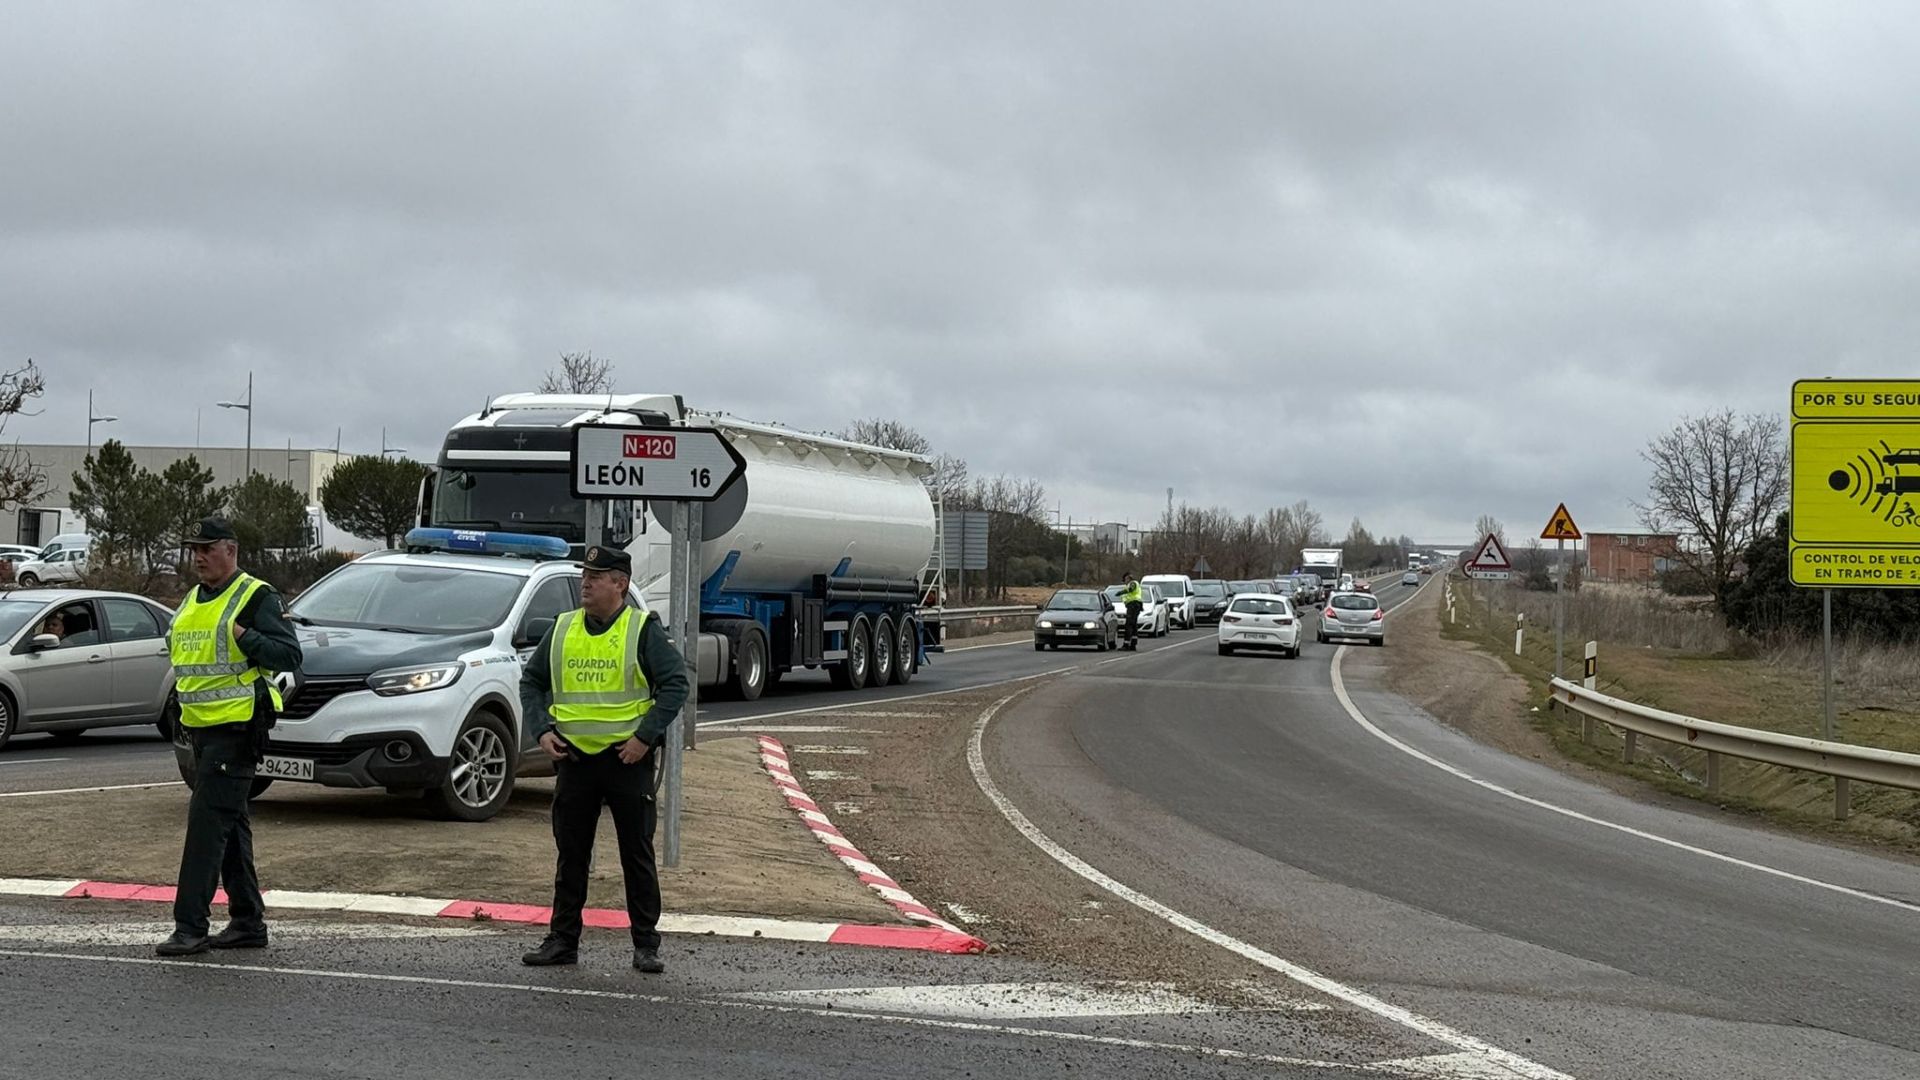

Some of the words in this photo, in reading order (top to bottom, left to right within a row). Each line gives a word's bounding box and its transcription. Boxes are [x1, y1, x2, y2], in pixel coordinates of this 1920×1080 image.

[1803, 394, 1836, 405] POR
[1843, 394, 1865, 405] SU
[625, 438, 674, 456] N-120
[585, 461, 644, 486] LEÓN
[690, 468, 711, 488] 16
[1804, 554, 1864, 564] CONTROL
[1869, 555, 1885, 564] DE
[1815, 569, 1832, 578] EN
[1837, 569, 1882, 578] TRAMO
[1886, 570, 1902, 579] DE
[176, 630, 212, 641] GUARDIA
[181, 642, 202, 652] CIVIL
[567, 659, 617, 669] GUARDIA
[576, 671, 606, 682] CIVIL
[266, 759, 299, 776] 9423
[302, 762, 312, 777] N
